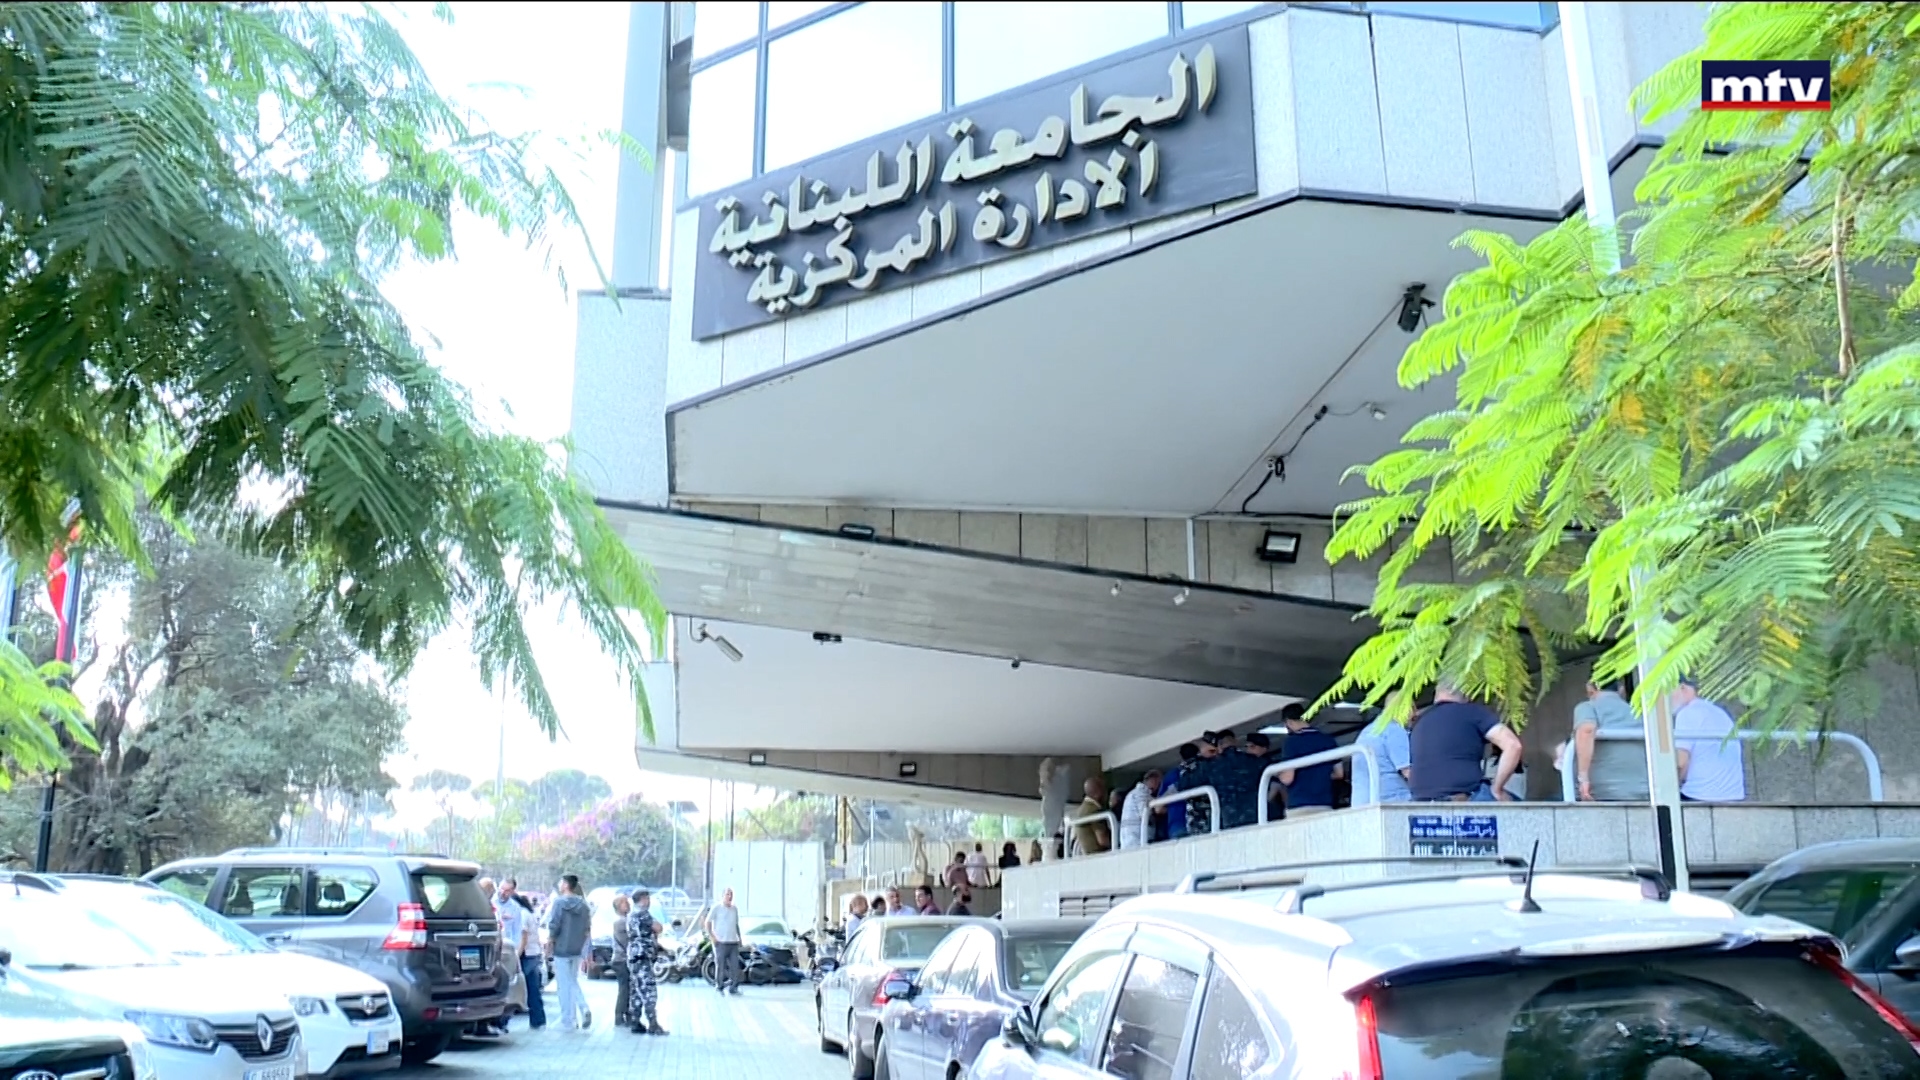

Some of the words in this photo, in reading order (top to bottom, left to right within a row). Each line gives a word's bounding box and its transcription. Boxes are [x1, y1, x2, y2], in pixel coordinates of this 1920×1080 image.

[942, 43, 1217, 184] الجامعة
[709, 133, 937, 269] اللبنانية
[746, 199, 958, 315] المركزية
[971, 139, 1160, 249] الادارة
